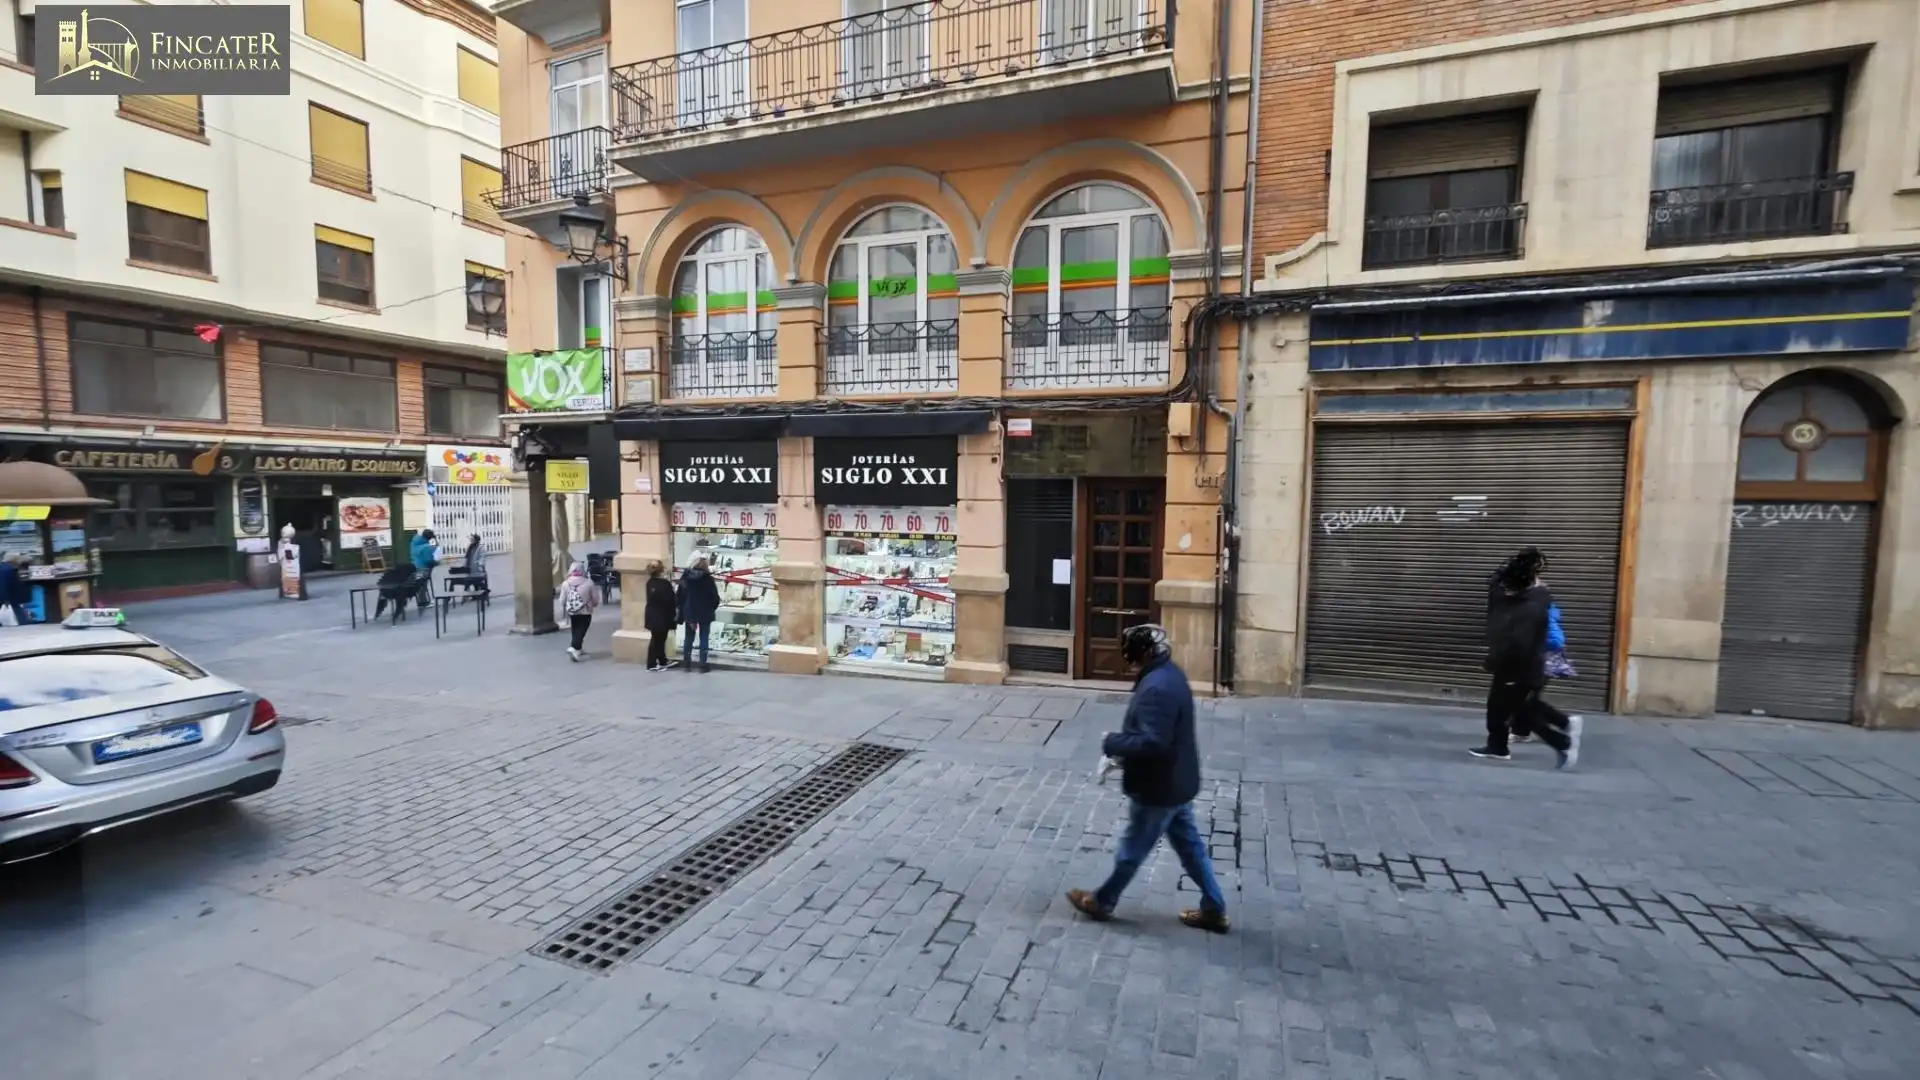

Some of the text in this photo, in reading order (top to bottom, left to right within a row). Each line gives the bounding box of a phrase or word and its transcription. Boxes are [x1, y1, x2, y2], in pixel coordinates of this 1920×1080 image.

[521, 358, 585, 400] VOX
[55, 450, 179, 468] CAFETERÍA
[255, 456, 285, 470] LAS
[289, 457, 347, 471] CUATRO
[690, 454, 744, 466] JOYERÍAS
[852, 453, 915, 465] JOYERÍAS
[664, 467, 772, 483] SIGLO XXI
[821, 467, 948, 484] SIGLO XXI
[672, 510, 777, 528] 60 70 70 60 70
[828, 513, 949, 533] 60 70 70 60 70
